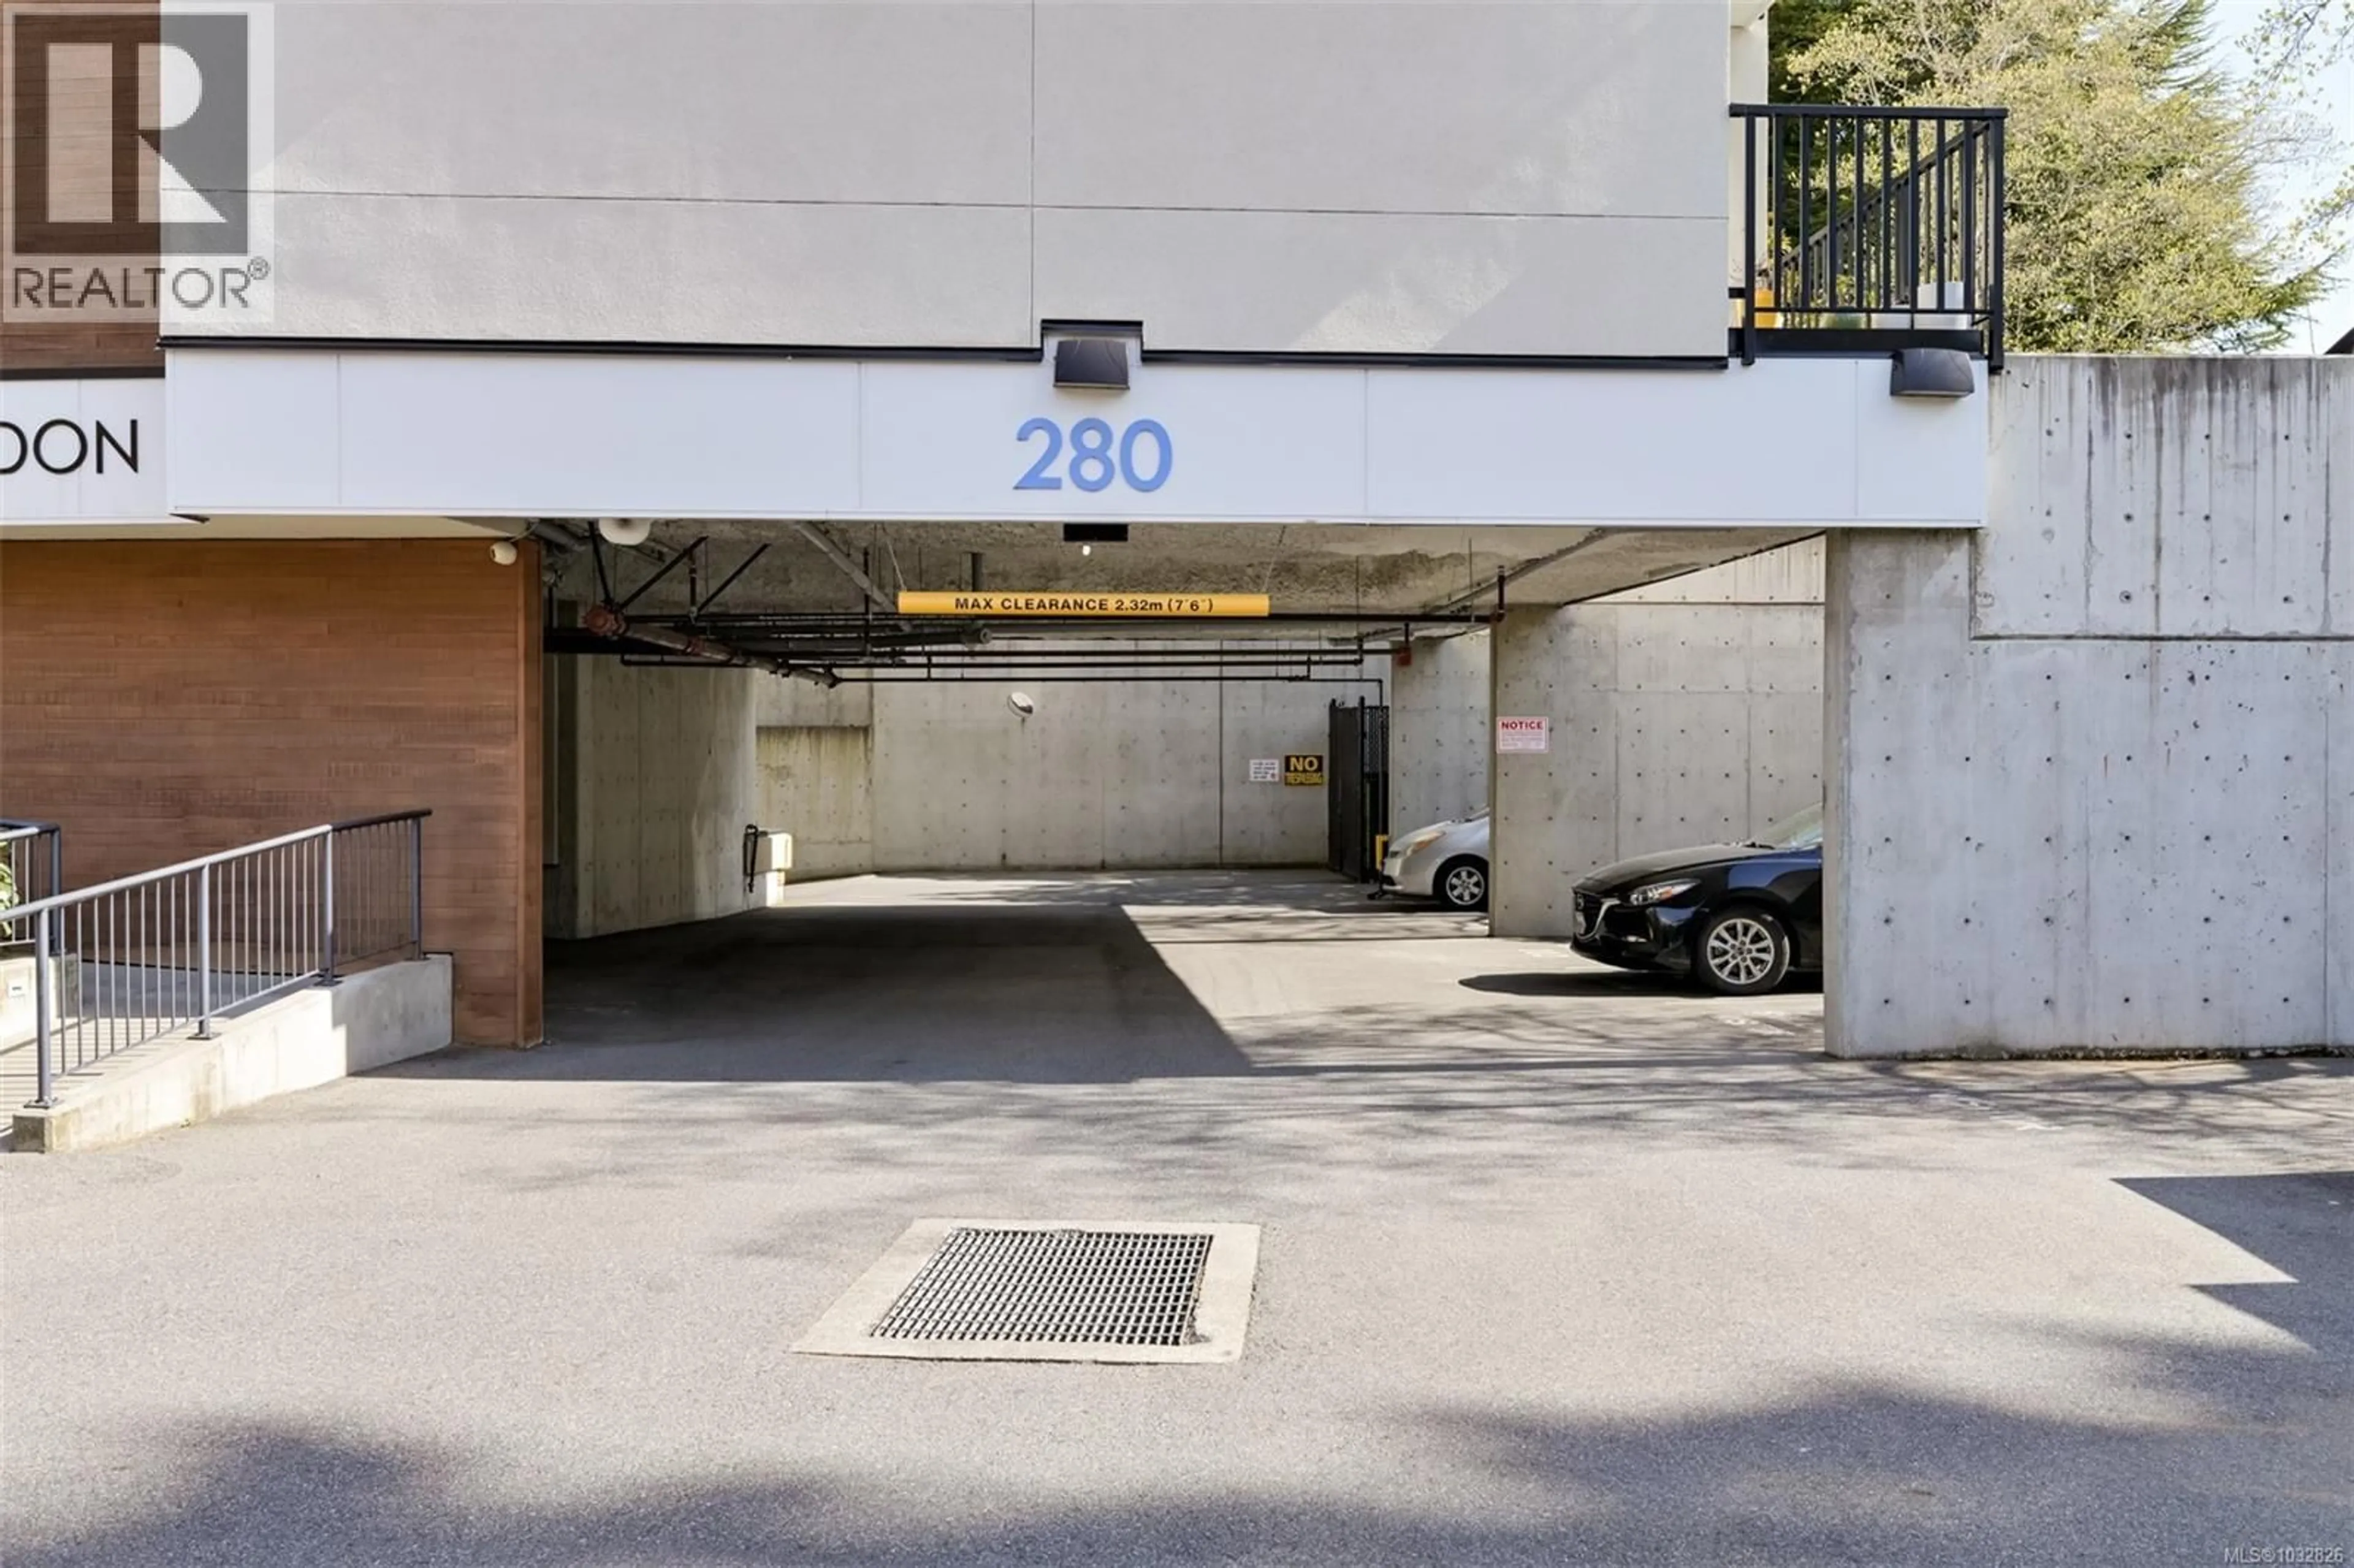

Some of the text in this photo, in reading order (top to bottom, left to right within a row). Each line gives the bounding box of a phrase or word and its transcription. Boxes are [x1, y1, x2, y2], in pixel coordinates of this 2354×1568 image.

[1013, 417, 1172, 492] 280
[954, 598, 993, 610] MAX
[1000, 598, 1109, 611] CLEARANCE
[1114, 599, 1163, 611] 2.32m
[1501, 720, 1543, 730] NOTICE
[1290, 756, 1318, 771] NO
